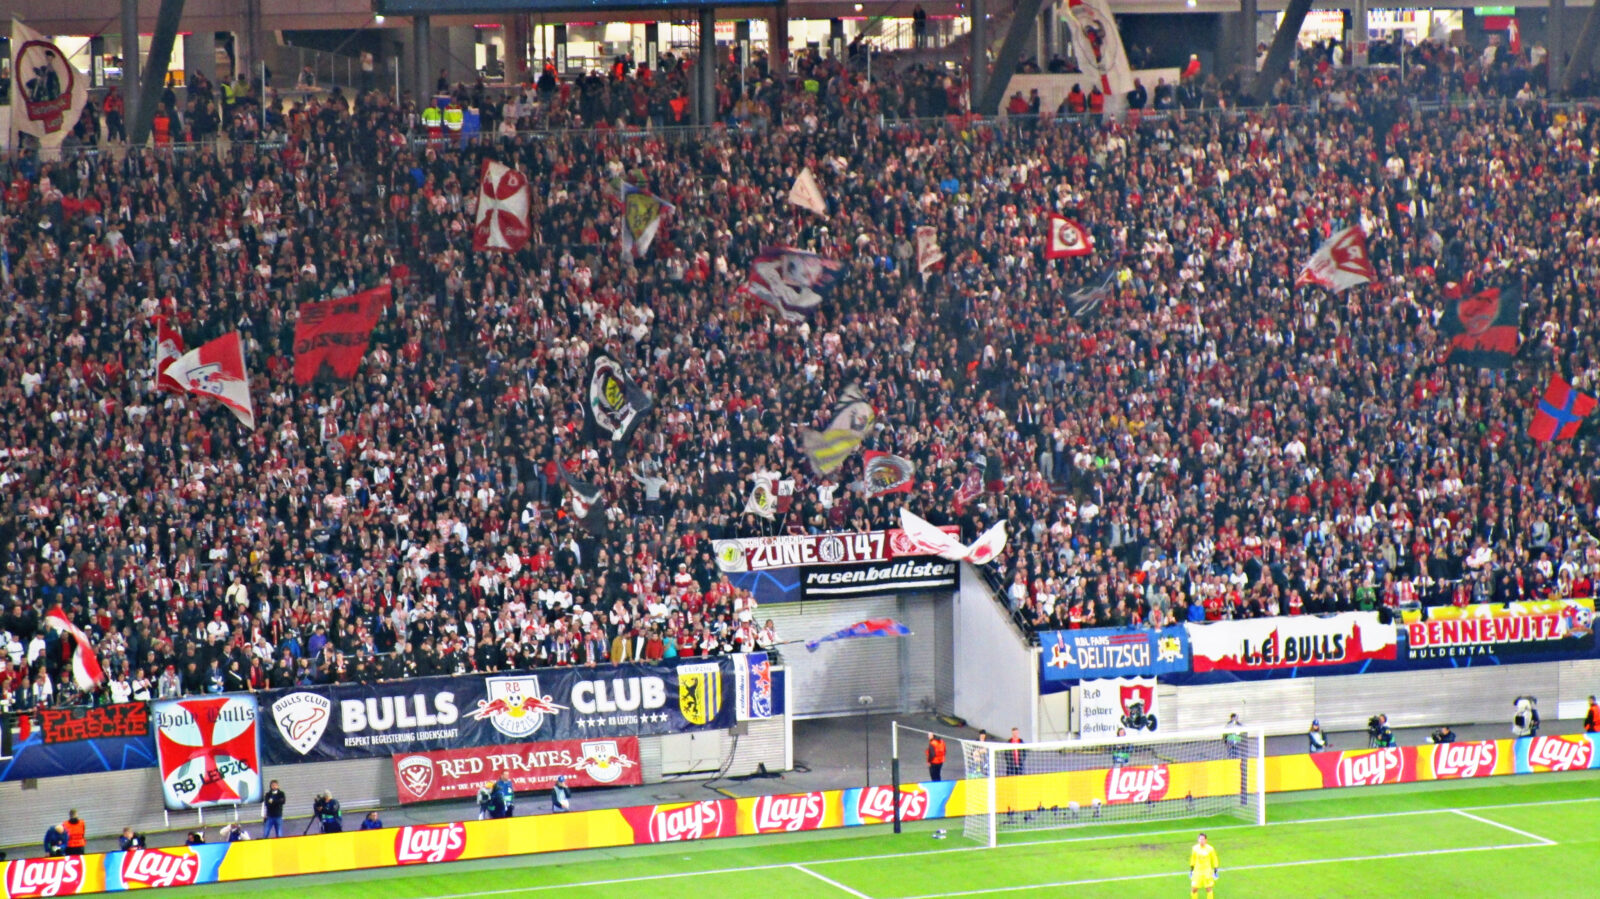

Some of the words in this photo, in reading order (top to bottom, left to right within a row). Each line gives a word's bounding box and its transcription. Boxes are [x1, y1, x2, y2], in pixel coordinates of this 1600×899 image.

[751, 538, 818, 567] ZONE
[847, 533, 885, 560] 147
[806, 560, 955, 584] rasenballisten
[1090, 636, 1110, 646] FANS
[1408, 614, 1563, 649] BENNEWITZ
[1077, 643, 1150, 670] DELITZSCH
[1284, 633, 1345, 665] BULLS
[1409, 645, 1494, 659] MULDENTAL
[505, 682, 521, 692] RB
[1083, 688, 1101, 699] Red
[40, 702, 146, 730] PLATZ
[155, 710, 198, 730] Holy
[207, 706, 255, 723] Bulls
[275, 695, 302, 712] BULLS
[304, 695, 328, 708] CLUB
[340, 691, 459, 733] BULLS
[571, 676, 667, 714] CLUB
[44, 718, 146, 743] HIRSCHE
[617, 714, 638, 725] LEIPZIG
[344, 736, 370, 747] RESPEKT
[371, 732, 415, 745] BEGEISTERUNG
[416, 728, 459, 740] LEIDENSCHAFT
[436, 757, 484, 779] RED
[486, 750, 573, 772] PIRATES
[1437, 740, 1494, 777] Lay's
[1531, 736, 1590, 770] Lay's
[173, 778, 196, 794] RB
[199, 758, 249, 786] LEIPZIG
[1108, 765, 1167, 802] Lay's
[759, 792, 820, 832] Lay's
[398, 822, 463, 863] Lay's
[11, 854, 79, 897] Lay's
[124, 849, 196, 888] Lay's
